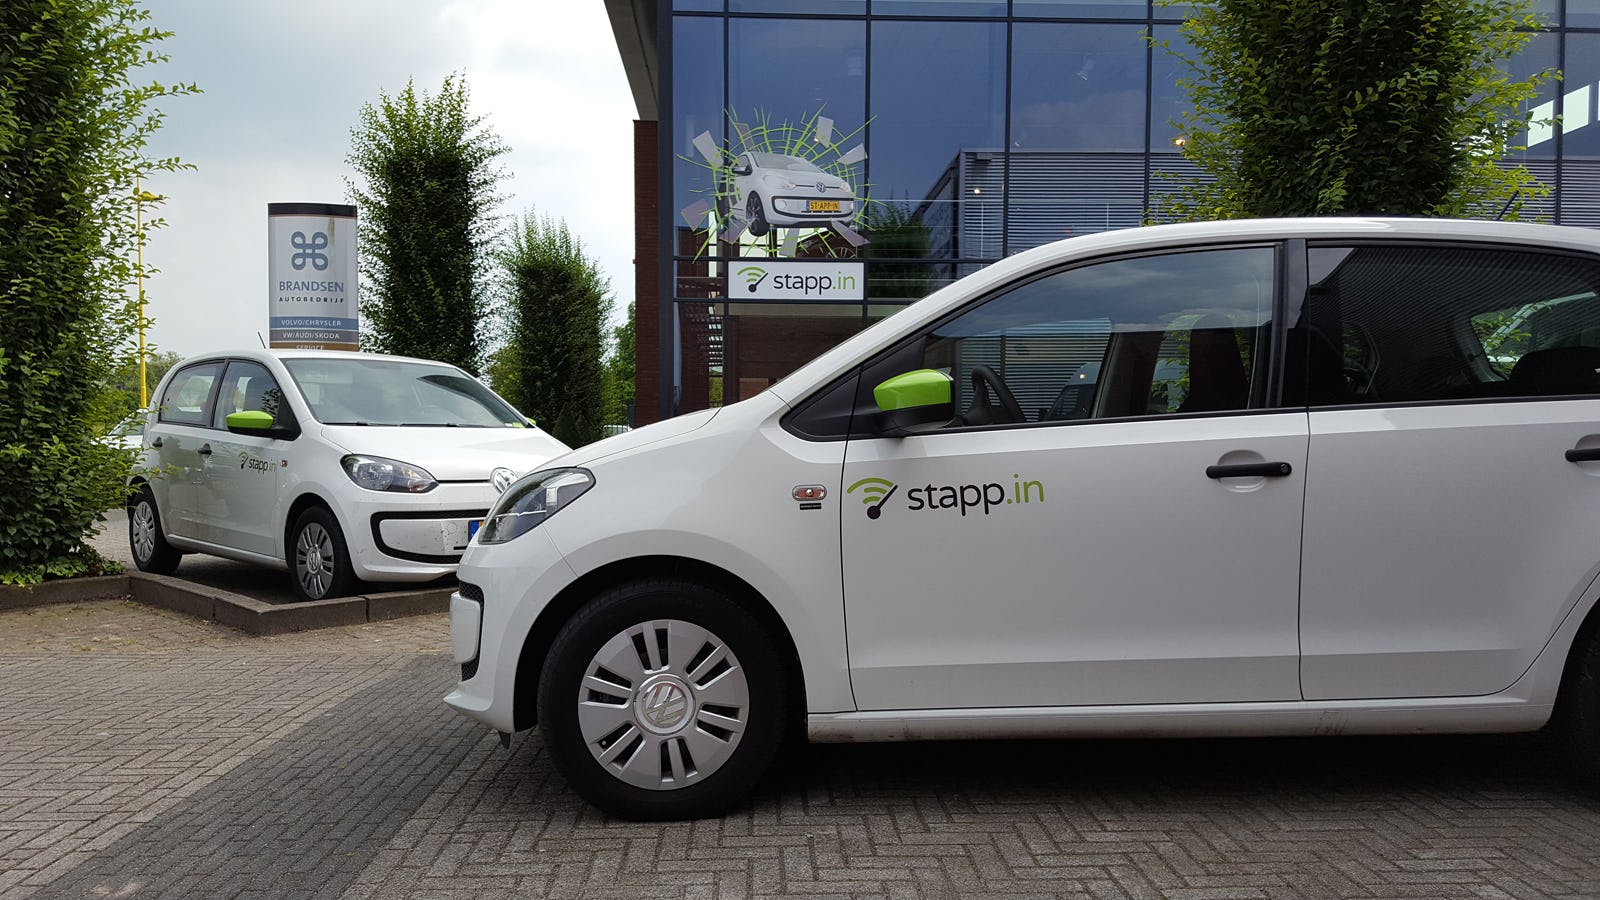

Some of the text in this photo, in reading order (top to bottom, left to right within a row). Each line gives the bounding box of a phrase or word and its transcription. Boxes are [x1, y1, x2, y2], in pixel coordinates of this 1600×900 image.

[279, 281, 344, 292] BRANDSEN
[773, 271, 856, 295] stapp.in
[281, 319, 342, 327] VOLVO/CHRYSLER
[907, 473, 1045, 517] stapp.in
